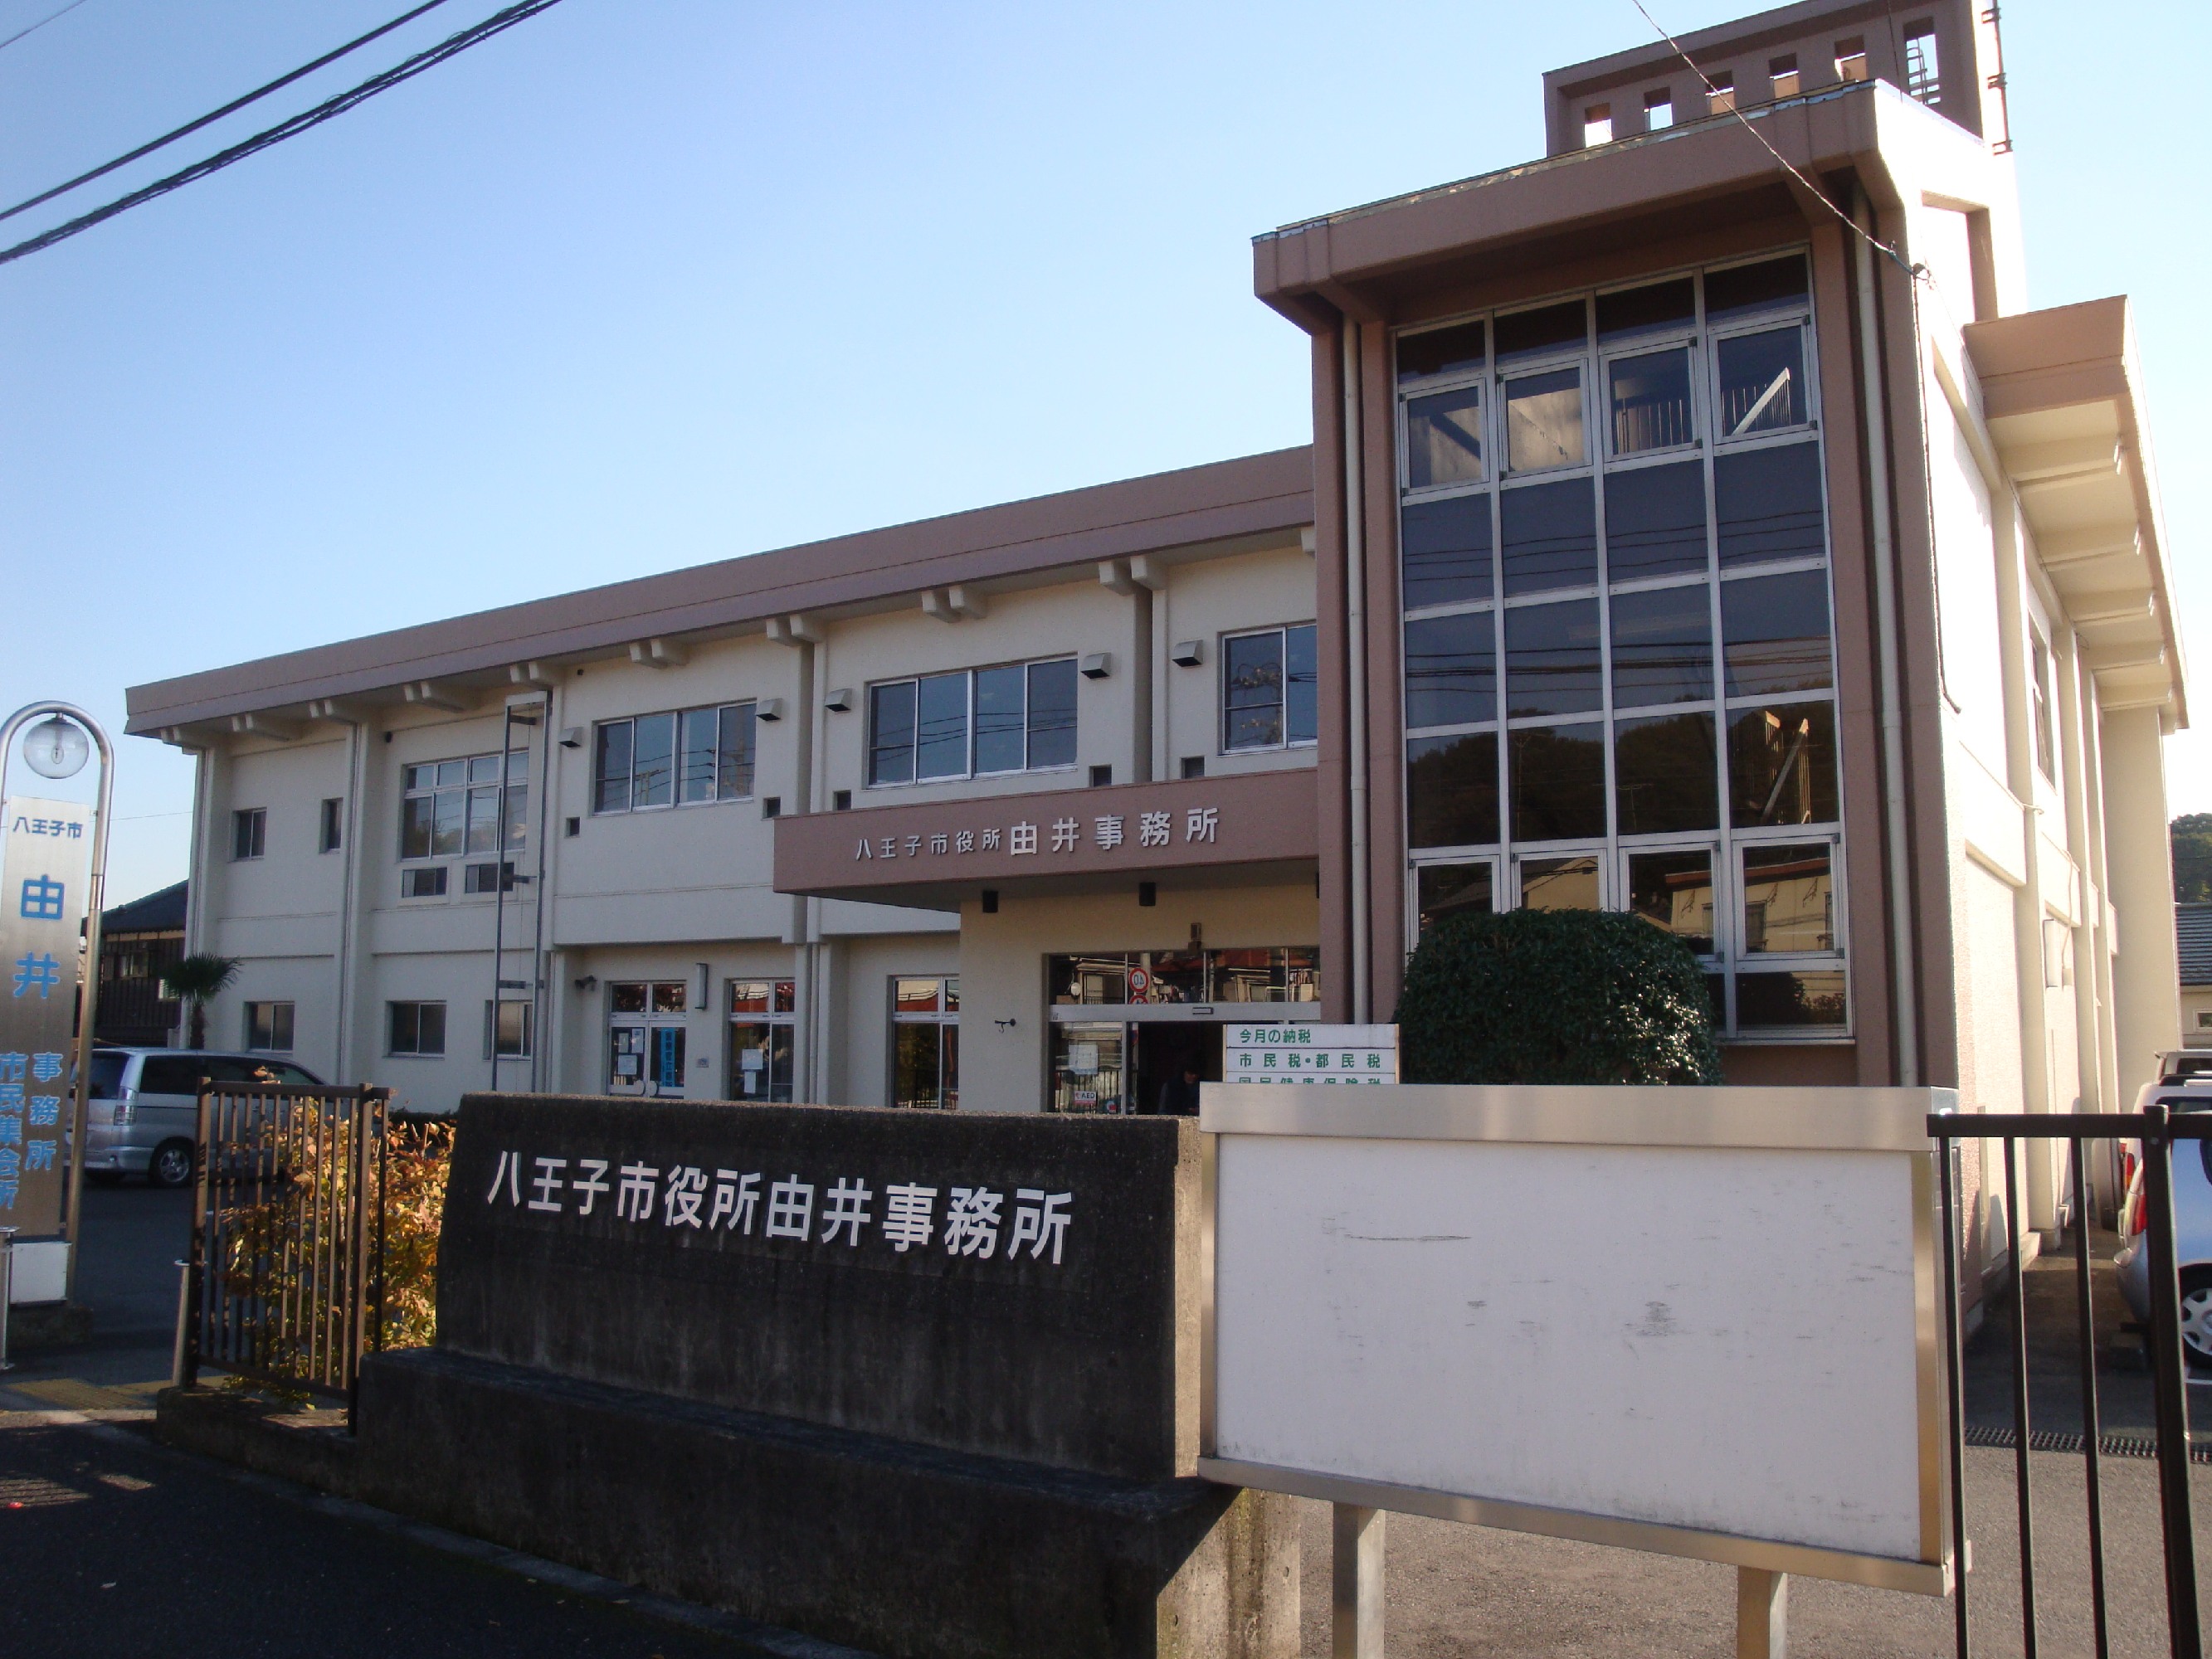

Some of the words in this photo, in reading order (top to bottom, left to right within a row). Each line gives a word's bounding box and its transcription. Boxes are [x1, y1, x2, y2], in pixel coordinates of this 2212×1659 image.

[12, 815, 83, 839] 八王子市
[1240, 1029, 1311, 1044] 今月の納税
[25, 1051, 64, 1171] 事務所
[486, 1151, 1073, 1265] 八王子市役所由井事務所
